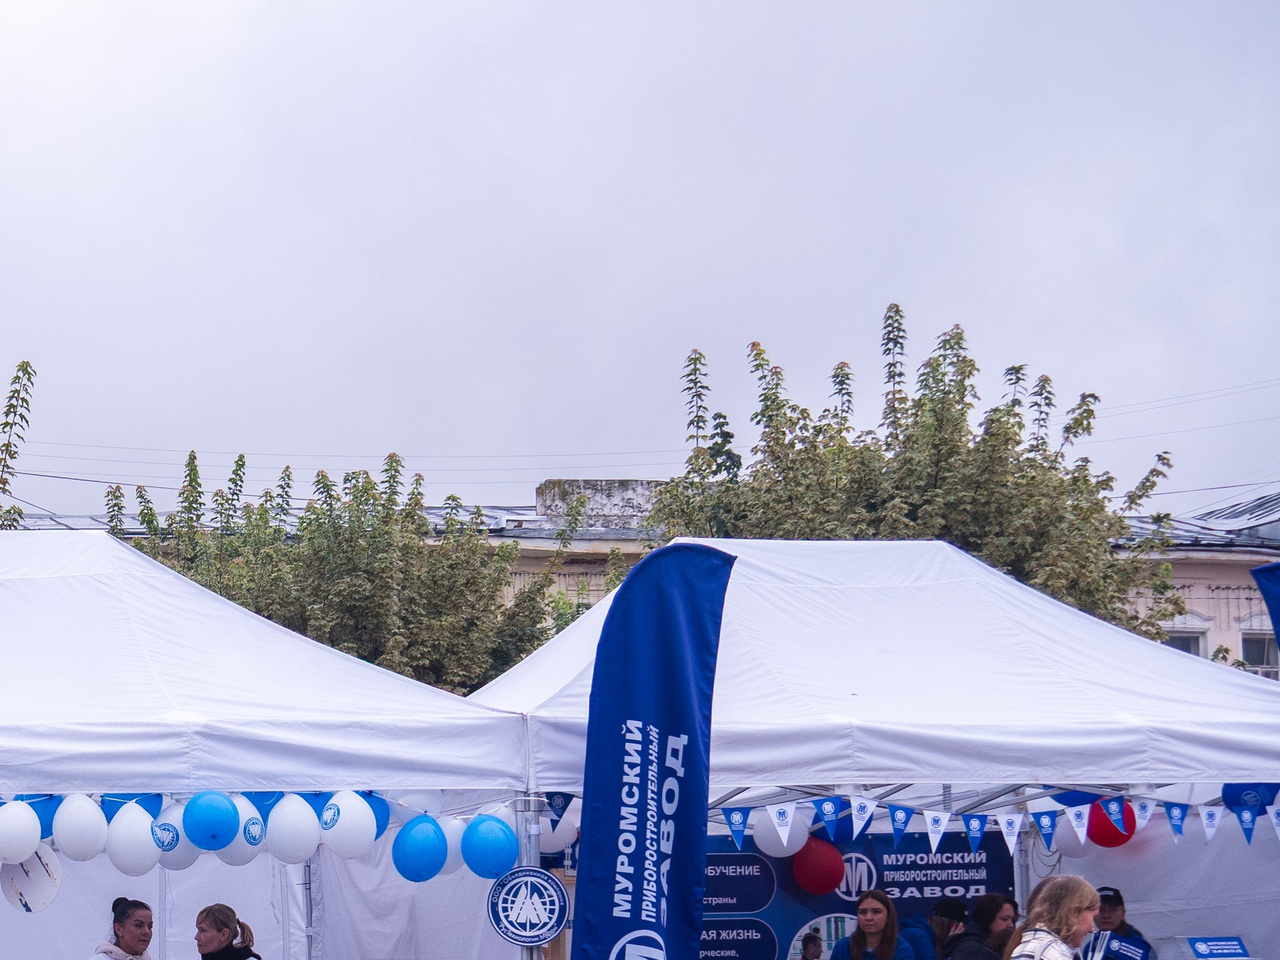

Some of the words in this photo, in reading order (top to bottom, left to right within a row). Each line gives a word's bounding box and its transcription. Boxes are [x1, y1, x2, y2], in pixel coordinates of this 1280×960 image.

[613, 719, 643, 918] МУРОМСКИЙ
[641, 724, 660, 923] ПРИБОРОСТРОИТЕЛЬНЫЙ
[659, 734, 688, 928] ЗАВОД
[883, 851, 987, 865] МУРОМСКИЙ
[705, 865, 761, 876] БУЧЕНИЕ
[883, 867, 987, 882] ПРИБОРОСТРОИТЕЛЬНЫЙ
[492, 885, 502, 903] ООО
[884, 885, 987, 899] ЗАВОД
[703, 897, 737, 906] страны
[720, 929, 761, 940] ЖИЗНЬ
